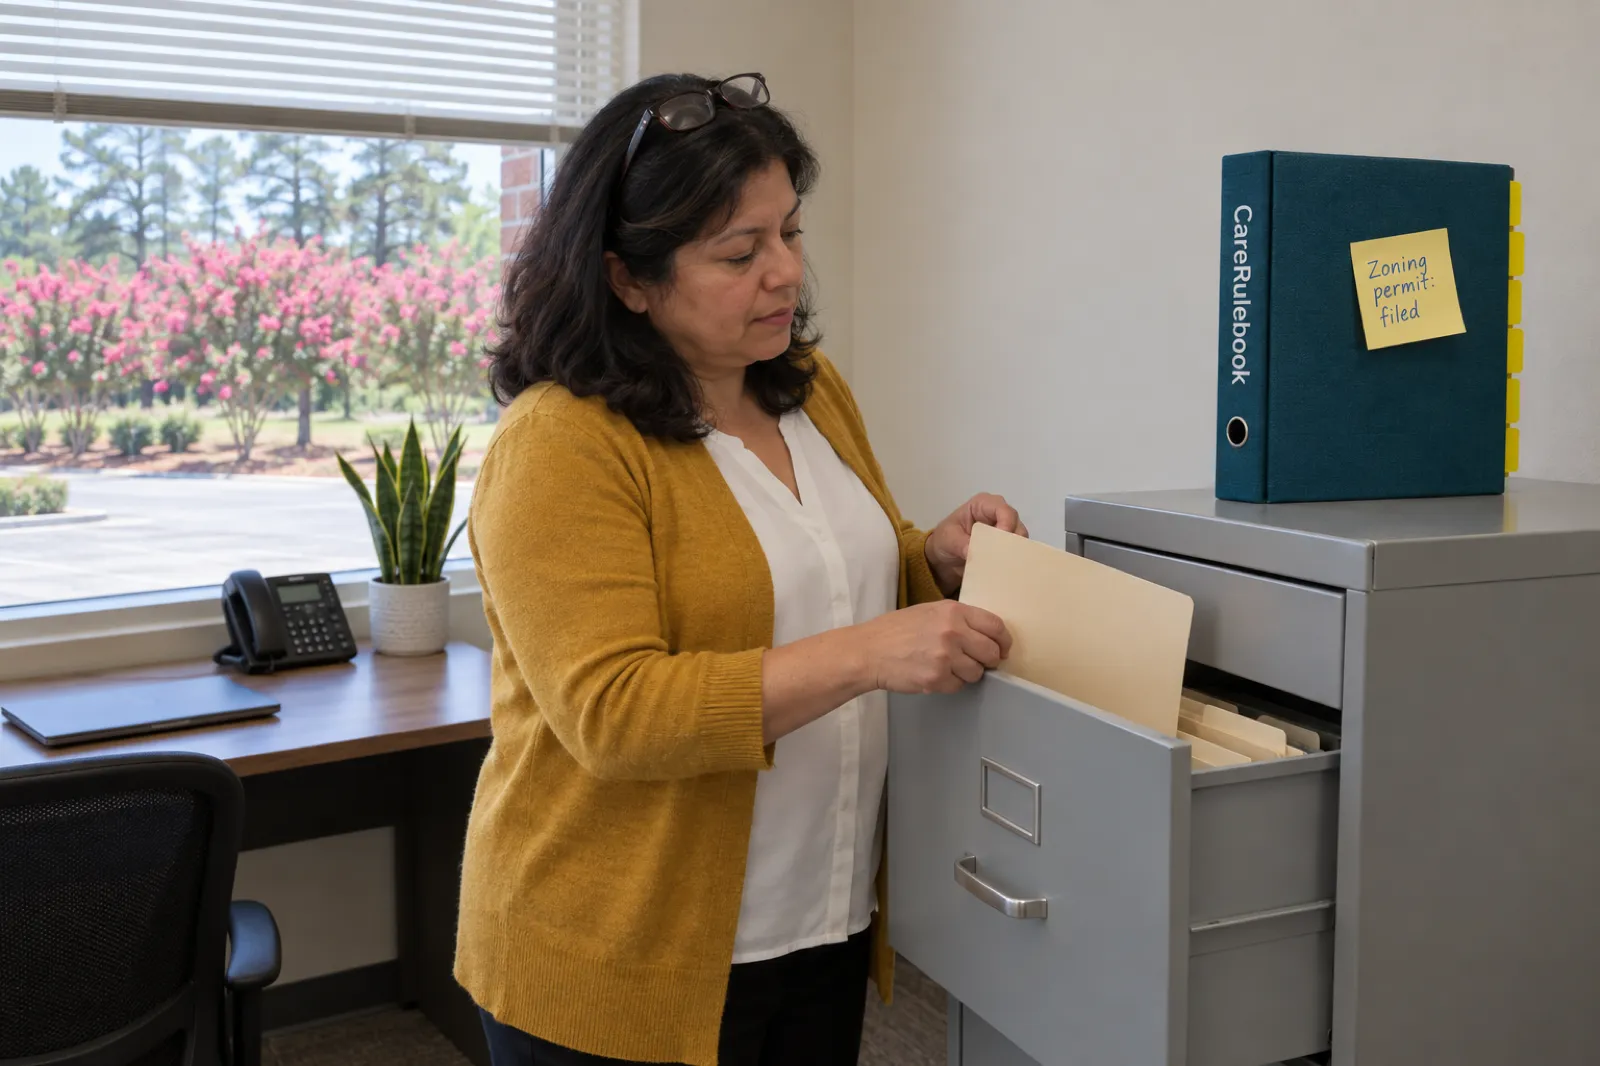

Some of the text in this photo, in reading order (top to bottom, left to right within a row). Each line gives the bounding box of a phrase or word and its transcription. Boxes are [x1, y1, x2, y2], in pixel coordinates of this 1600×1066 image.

[1367, 256, 1428, 279] Zoning
[1231, 205, 1253, 385] CareRulebook
[1373, 276, 1435, 307] permit:
[1380, 300, 1420, 327] filed
